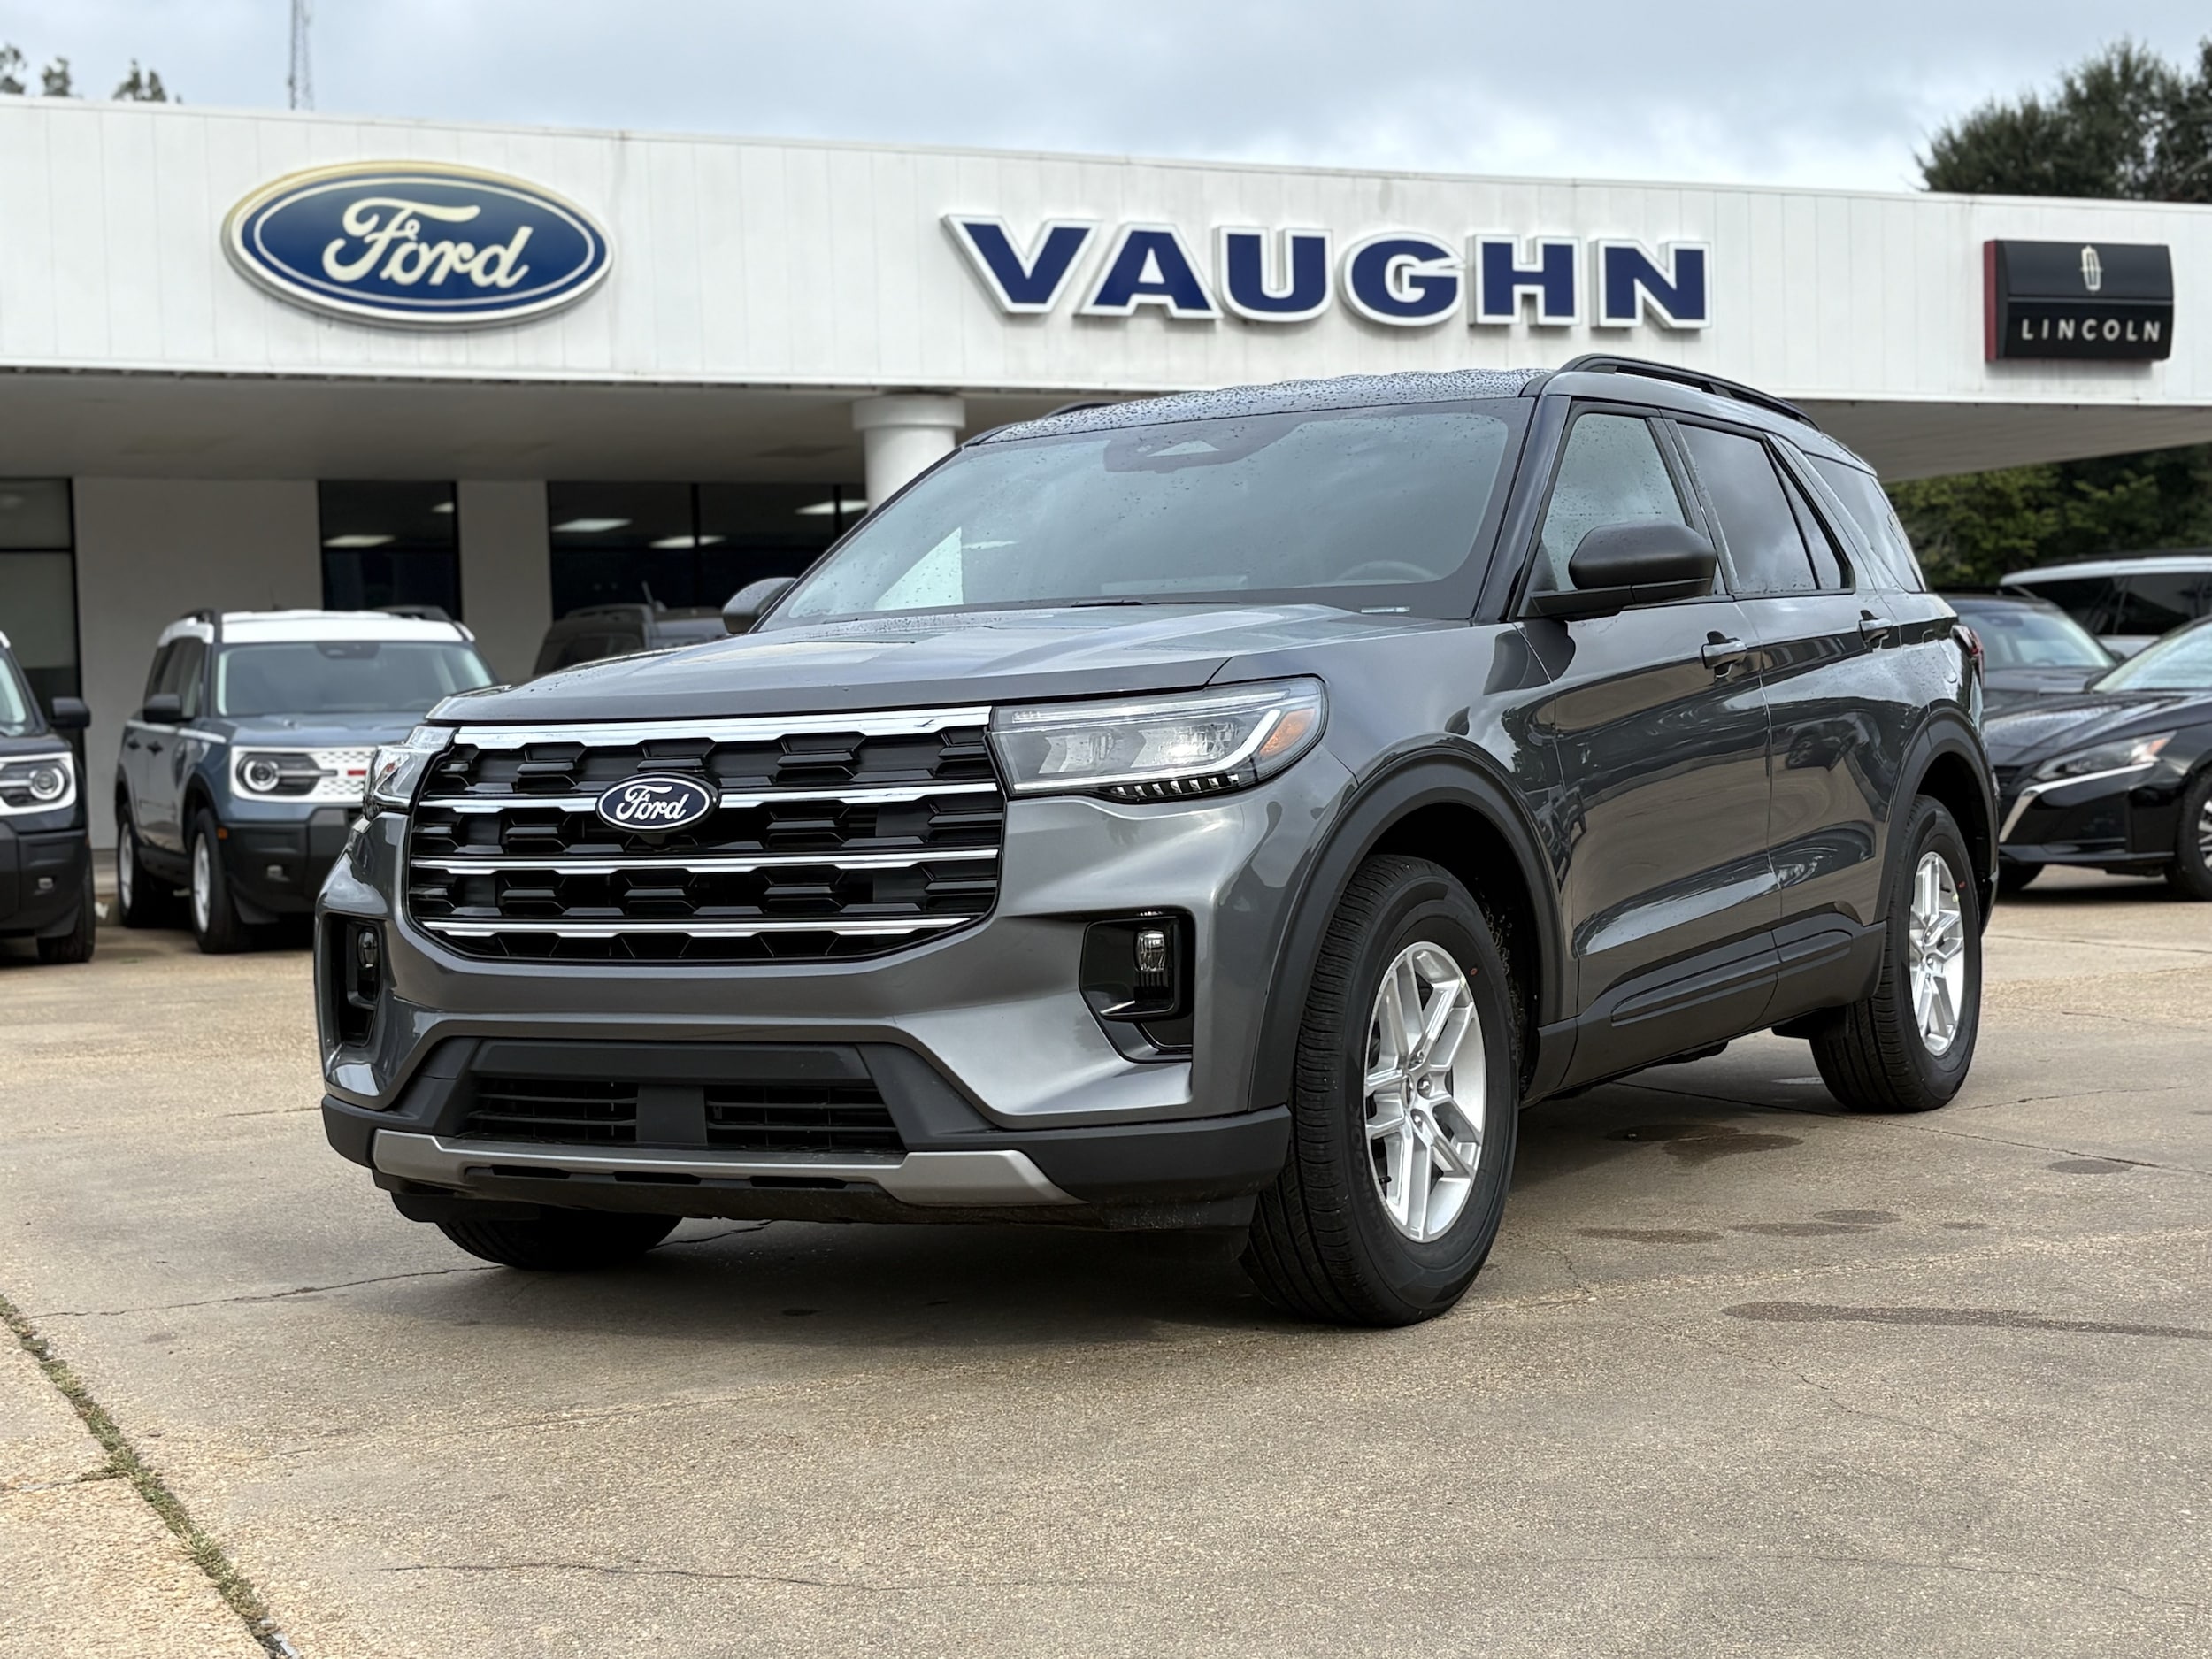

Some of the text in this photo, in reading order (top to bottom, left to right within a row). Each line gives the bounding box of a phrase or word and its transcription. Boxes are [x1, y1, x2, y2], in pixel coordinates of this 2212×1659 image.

[322, 196, 533, 288] Ford
[943, 215, 1711, 328] VAUGHN
[2021, 319, 2162, 342] LINCOLN
[615, 784, 690, 820] Ford
